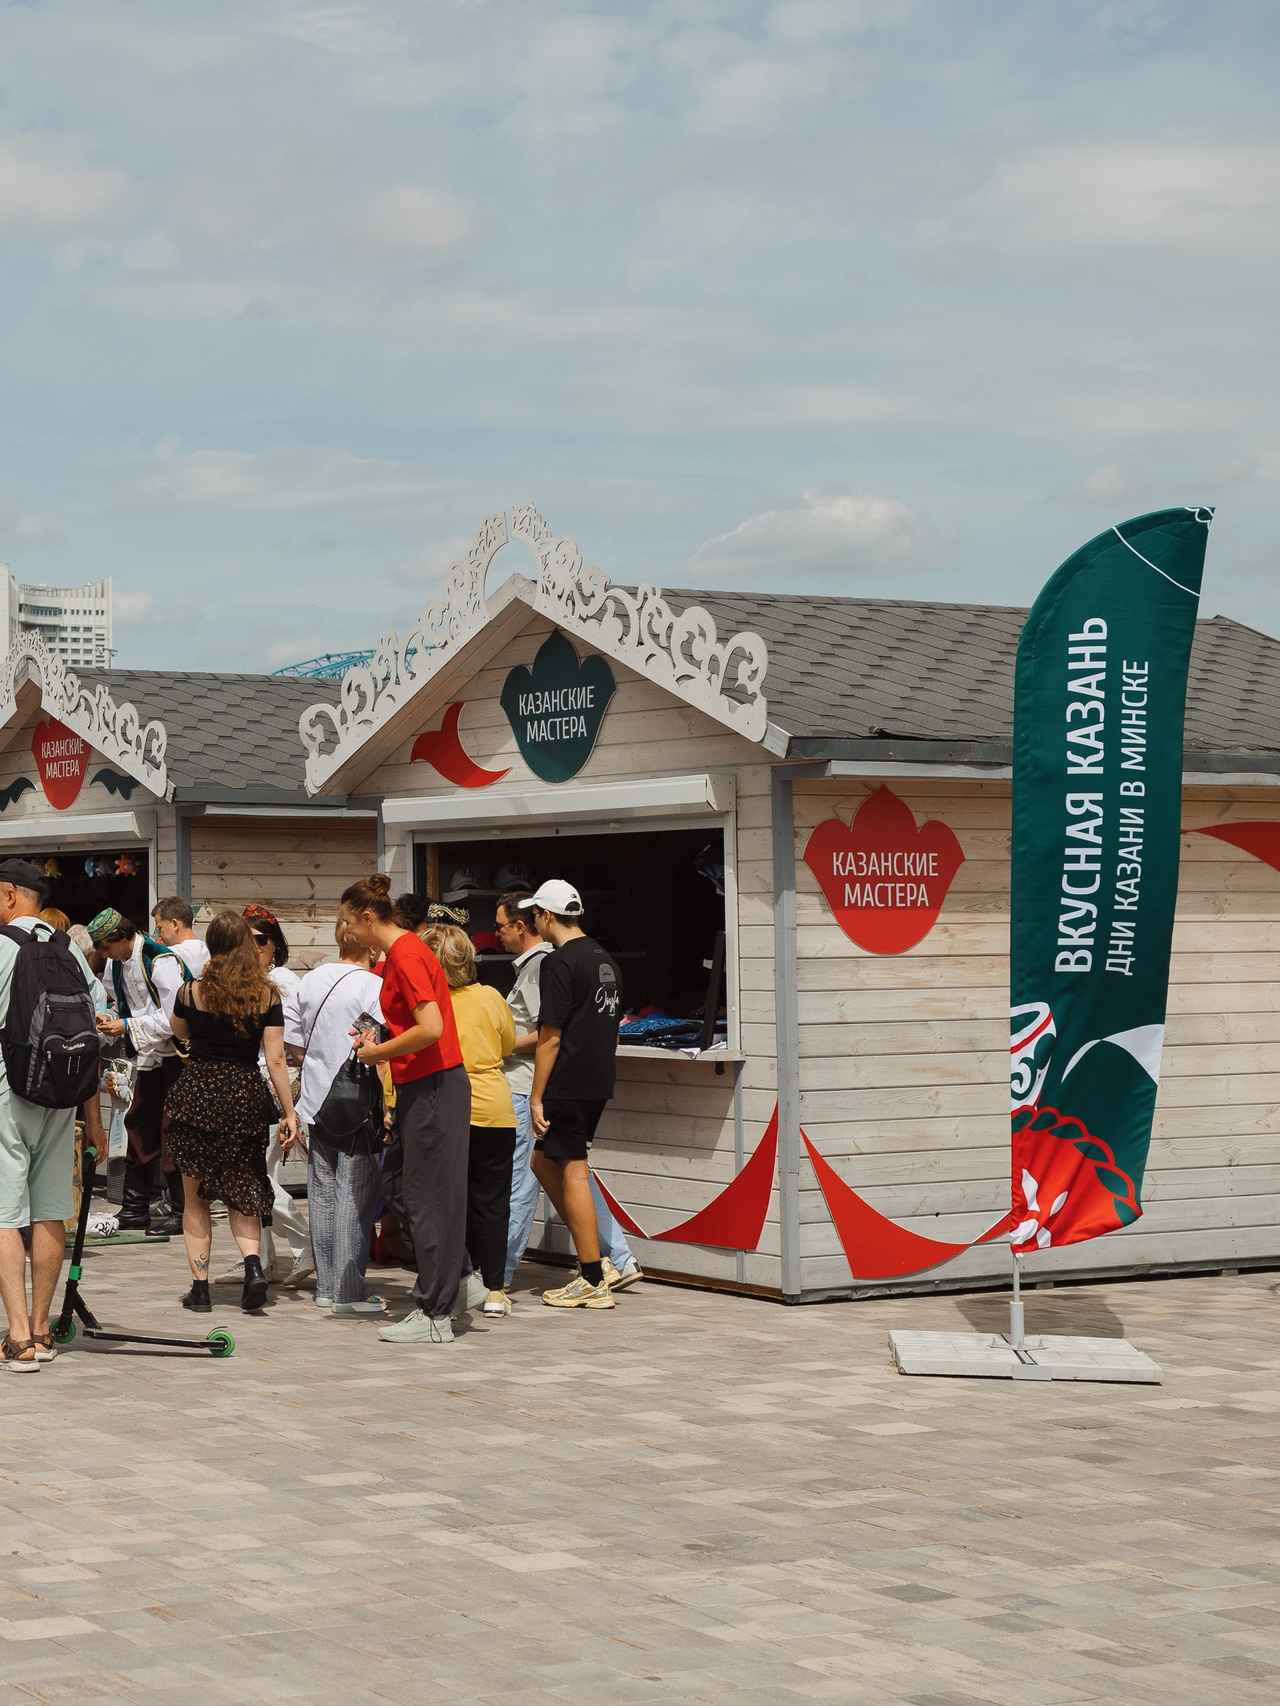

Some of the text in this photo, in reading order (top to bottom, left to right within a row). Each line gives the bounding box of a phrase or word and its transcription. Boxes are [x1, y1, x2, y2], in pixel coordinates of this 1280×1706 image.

[518, 685, 595, 716] КАЗАНСКИЕ
[526, 715, 587, 743] МАСТЕРА
[41, 737, 85, 759] КАЗАНСКИЕ
[45, 759, 80, 780] МАСТЕРА
[1054, 617, 1108, 972] ВКУСНАЯ КАЗАНЬ
[1105, 660, 1149, 976] ДНИ КАЗАНИ В МИНСКЕ
[832, 851, 939, 877] КАЗАНСКИЕ
[844, 883, 930, 907] МАСТЕРА
